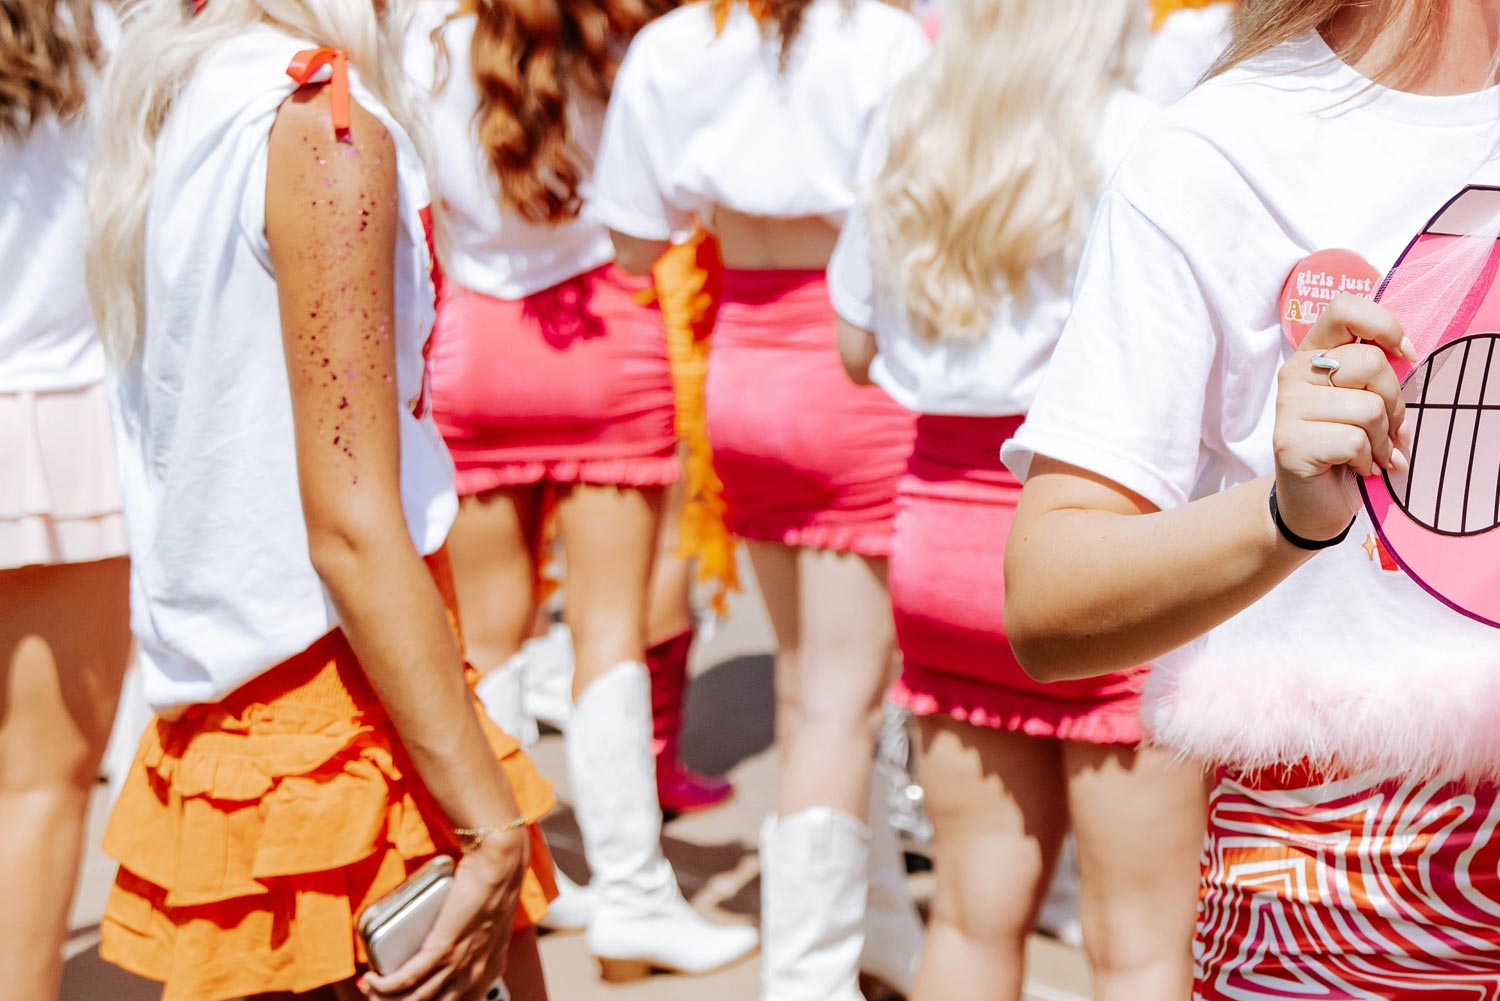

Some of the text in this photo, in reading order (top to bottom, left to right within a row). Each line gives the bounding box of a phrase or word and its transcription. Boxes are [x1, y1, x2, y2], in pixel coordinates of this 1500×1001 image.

[1297, 270, 1371, 292] girls just
[1296, 284, 1348, 300] wann
